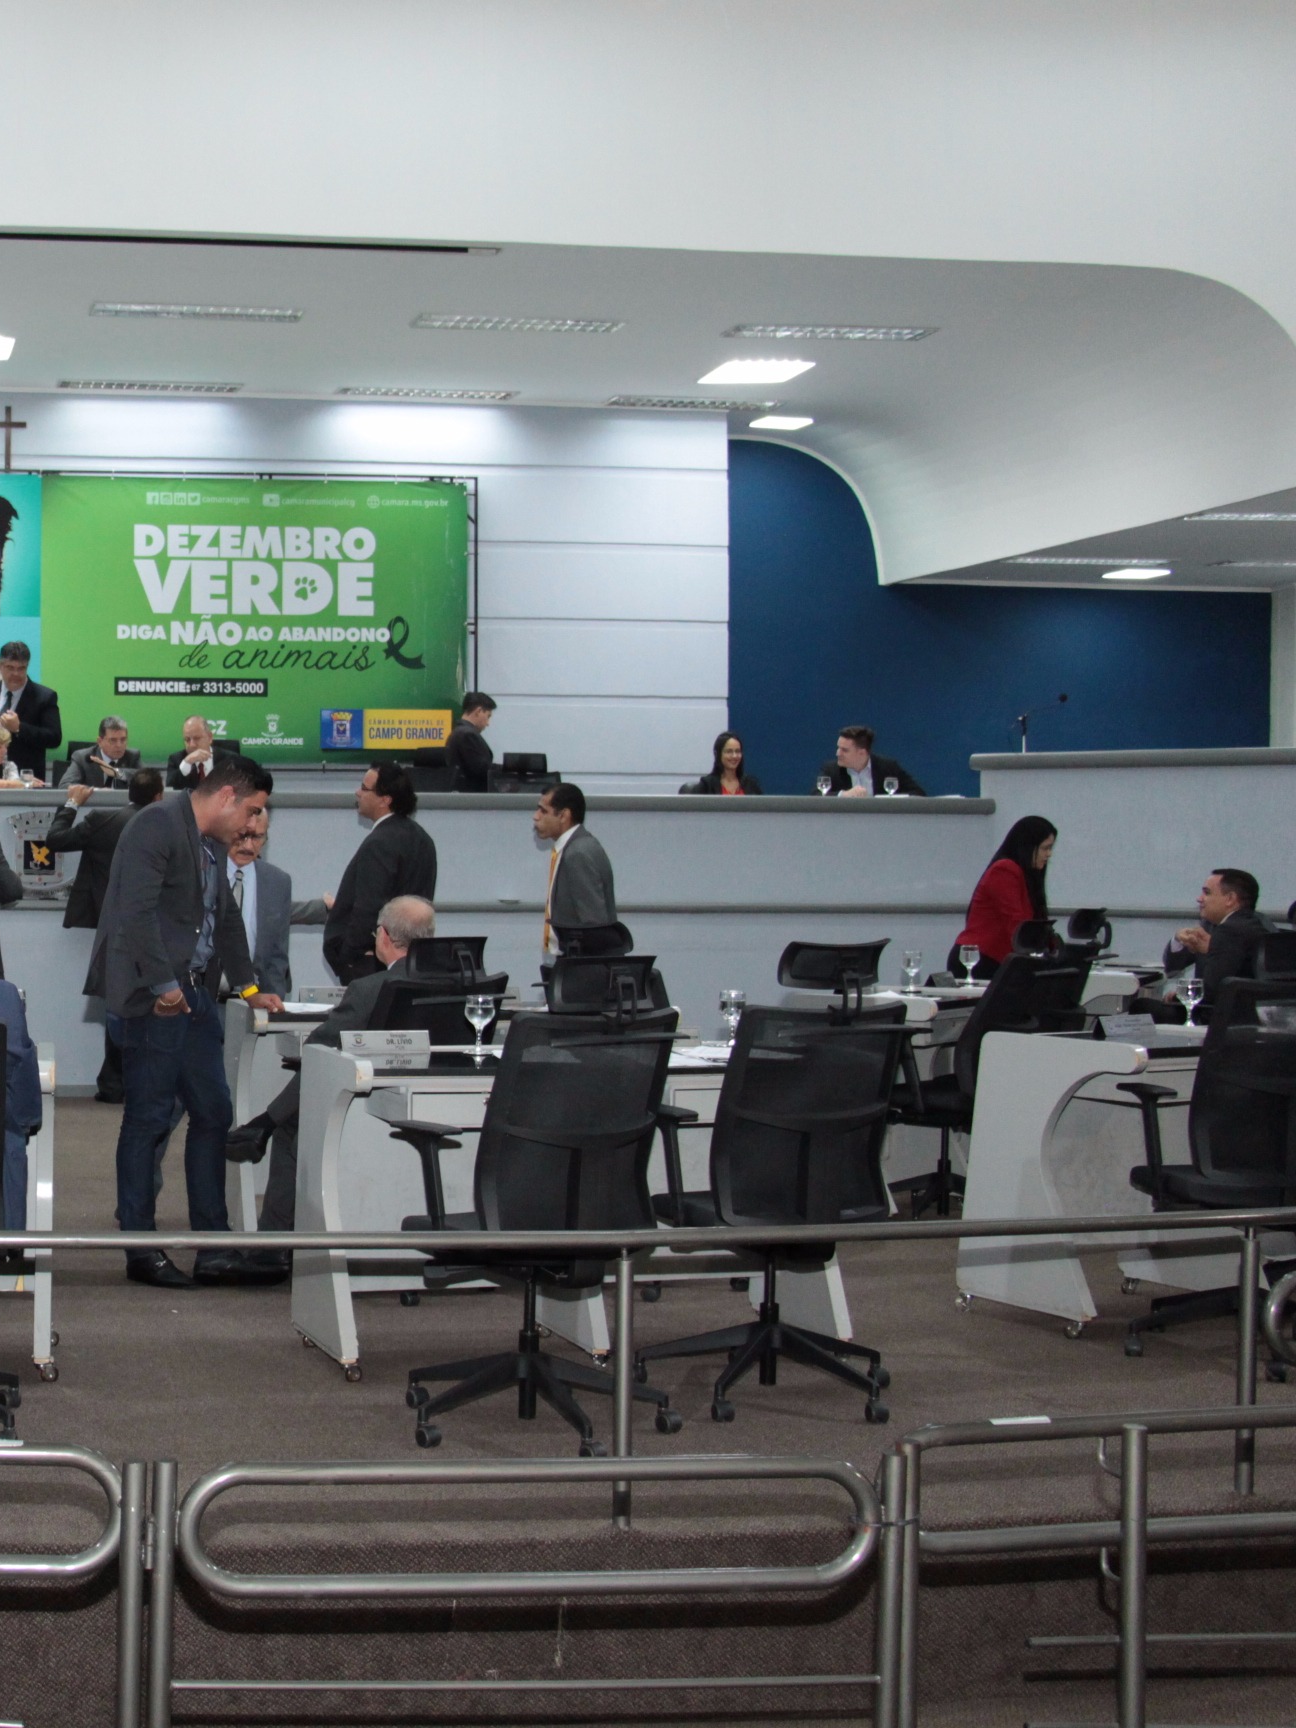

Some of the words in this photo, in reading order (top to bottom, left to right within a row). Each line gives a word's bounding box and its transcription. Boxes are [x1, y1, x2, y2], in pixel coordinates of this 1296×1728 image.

[381, 499, 449, 508] camara.ms.gov.br
[133, 524, 377, 561] DEZEMBRO
[133, 558, 375, 616] VERDE
[116, 624, 167, 640] DIGA
[170, 614, 243, 646] NÃO
[244, 625, 274, 642] AO
[277, 626, 391, 643] ABANDONO
[178, 639, 212, 669] de
[222, 643, 376, 672] animais
[117, 680, 191, 694] DENUNCIE:
[203, 681, 264, 694] 3313-5000
[368, 727, 403, 740] CAMPO
[405, 727, 444, 740] GRANDE
[241, 737, 271, 746] CAMPO
[271, 737, 304, 746] GRANDE
[386, 1038, 397, 1046] DR.
